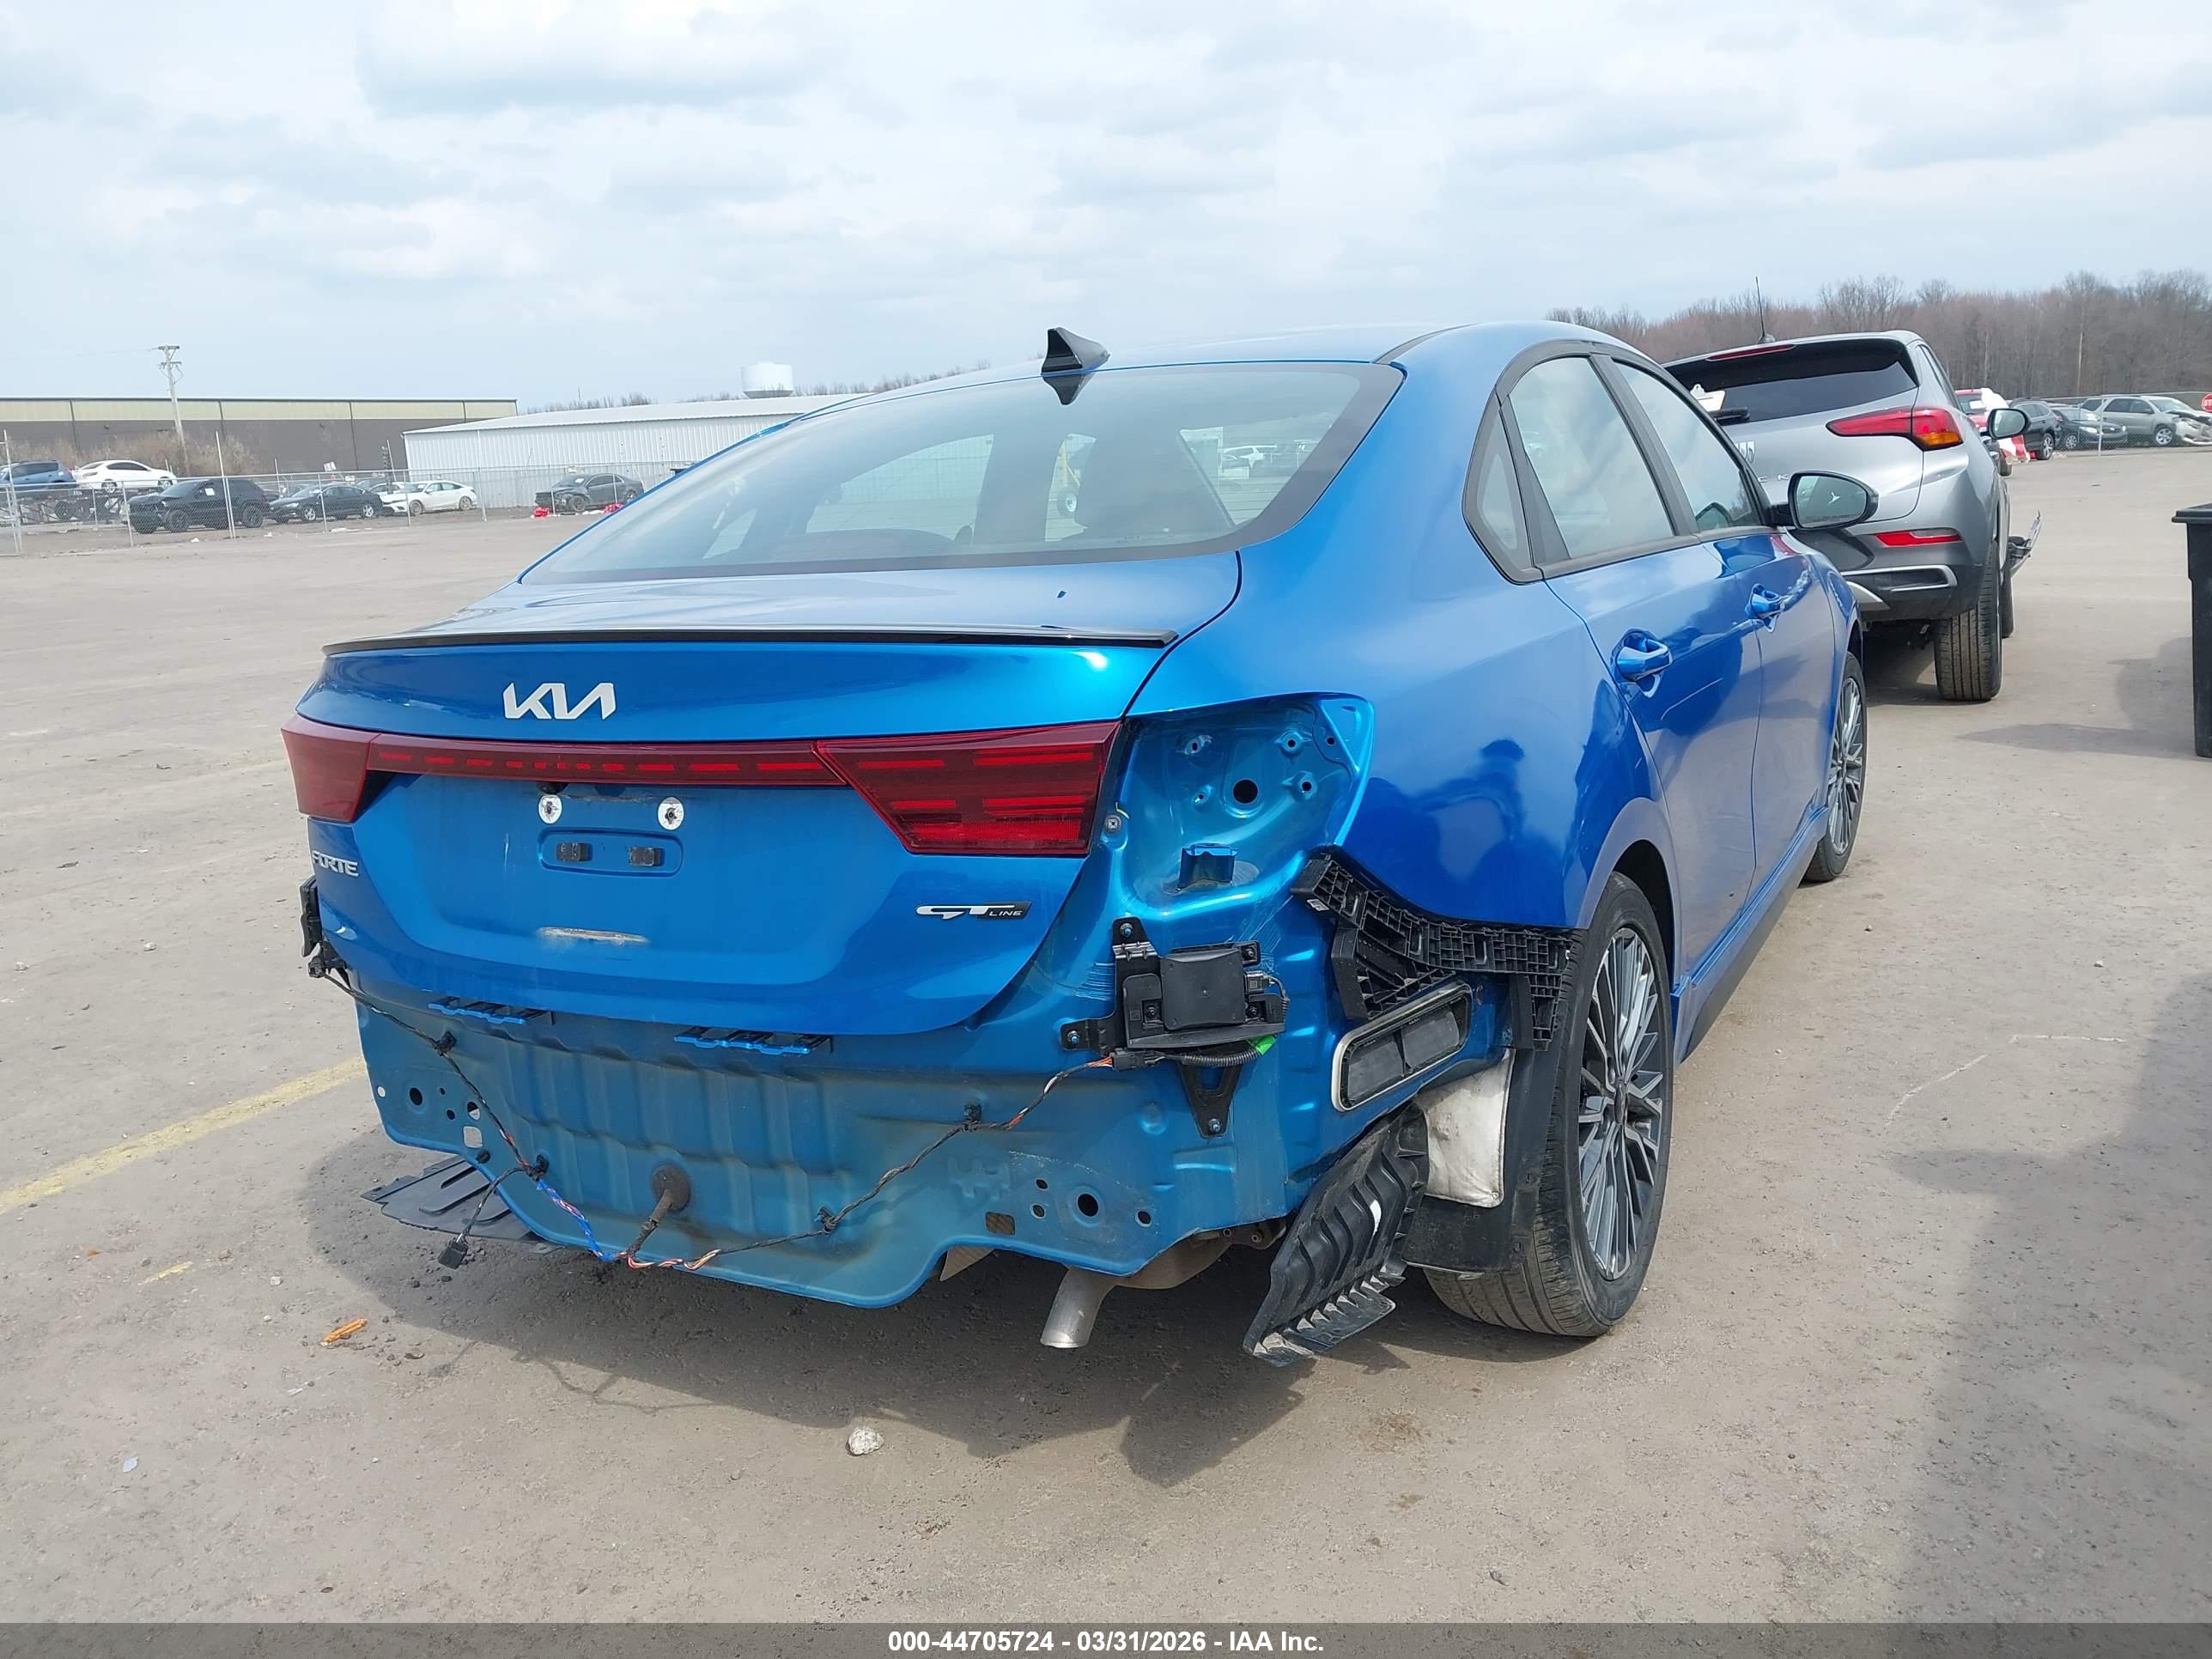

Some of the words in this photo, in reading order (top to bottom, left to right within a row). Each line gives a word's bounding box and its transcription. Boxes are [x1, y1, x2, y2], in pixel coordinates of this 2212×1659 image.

[503, 682, 617, 720] KIA
[312, 850, 360, 877] FORTE
[916, 904, 1015, 920] GT
